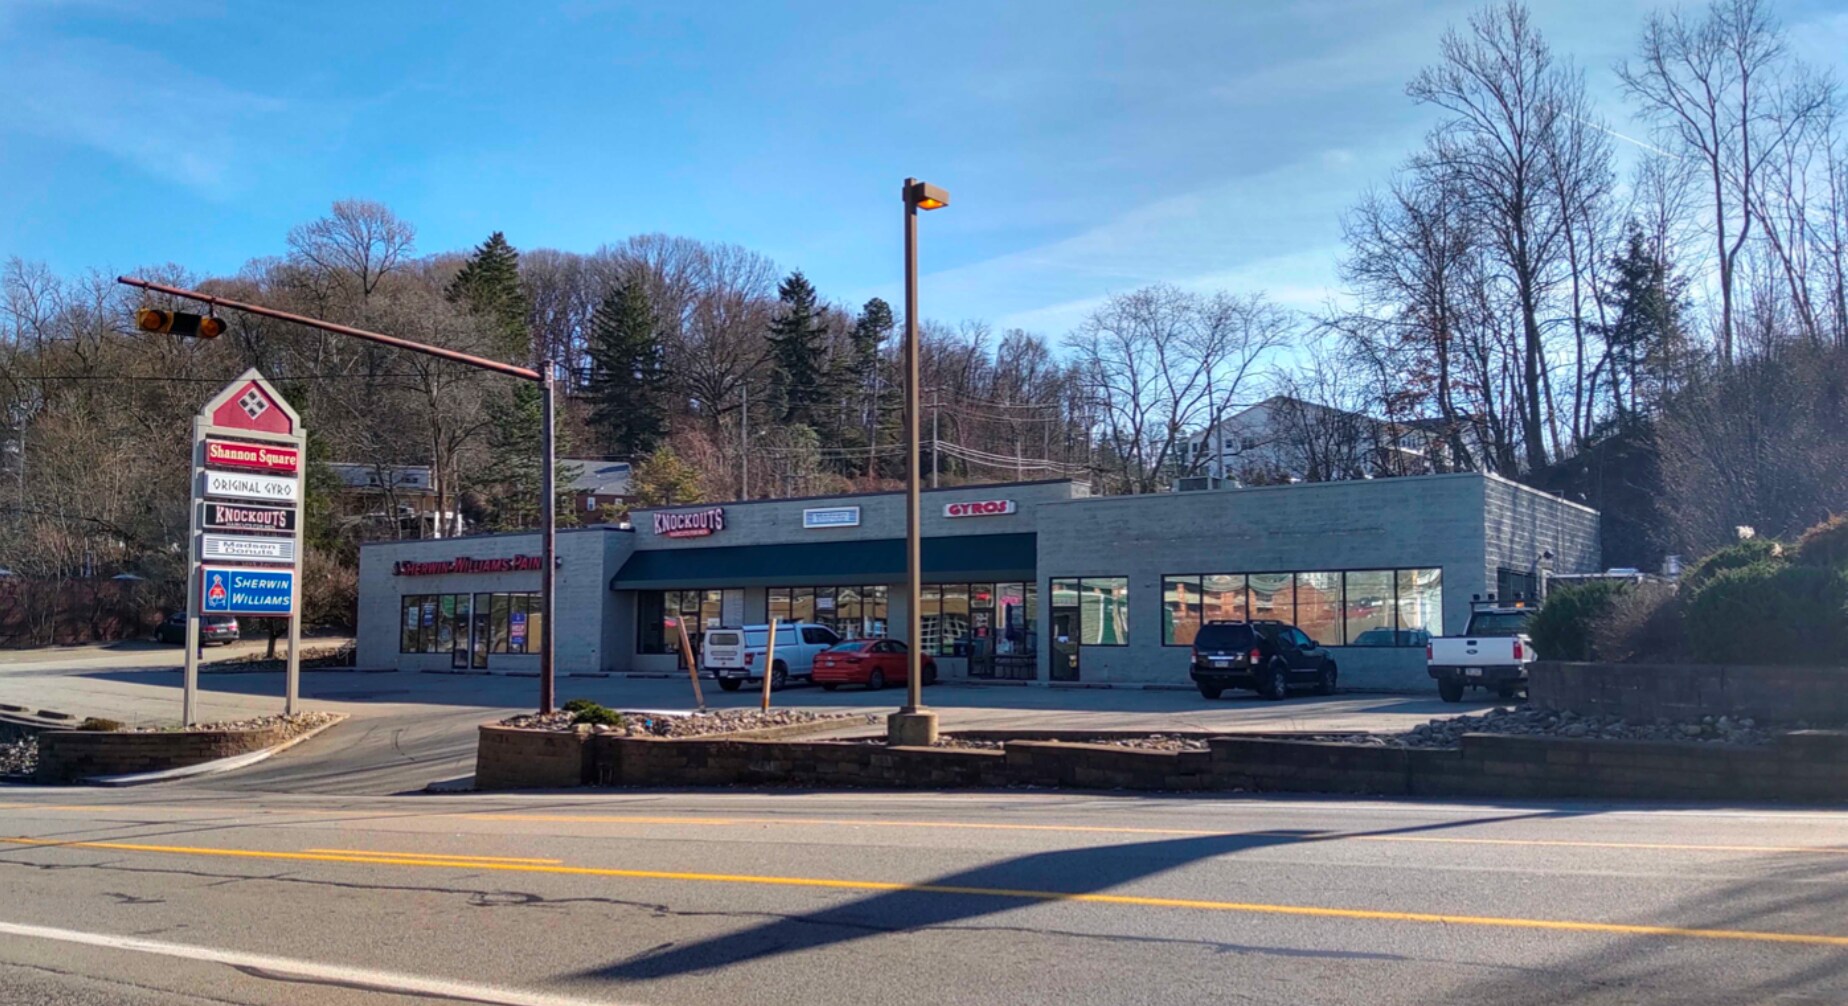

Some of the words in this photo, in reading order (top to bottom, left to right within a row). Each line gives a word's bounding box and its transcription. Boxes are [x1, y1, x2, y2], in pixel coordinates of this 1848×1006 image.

[210, 444, 257, 461] Shannon
[259, 449, 296, 466] Square
[213, 478, 261, 493] ORIGINAL
[265, 482, 292, 495] GYRO
[215, 505, 287, 527] KNOCKOUTS
[948, 501, 1007, 515] GYROS
[653, 508, 723, 535] KNOCKOUTS
[234, 576, 289, 589] SHERWIN
[232, 593, 290, 606] WILLIAMS
